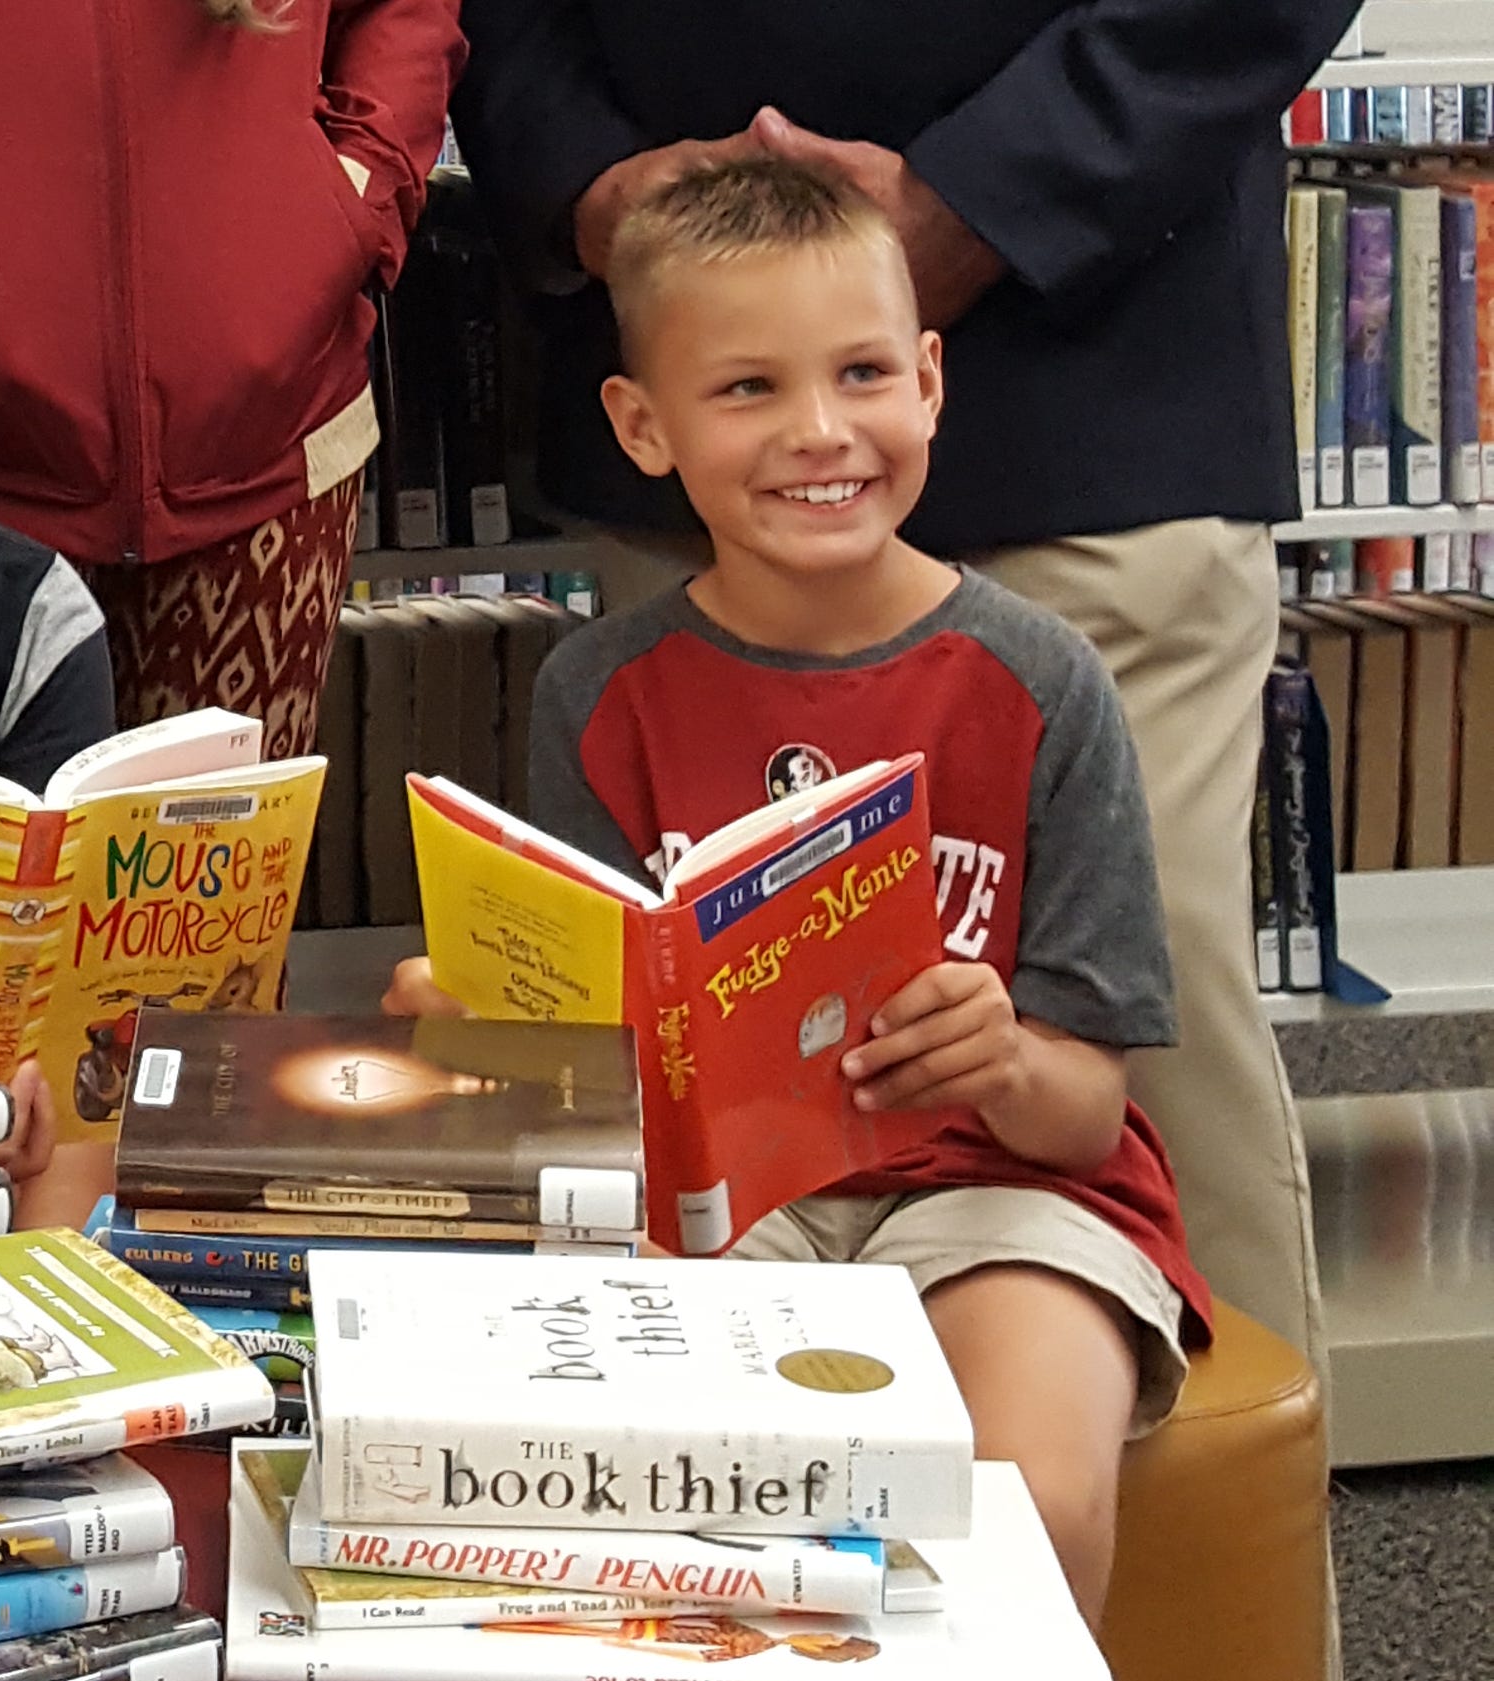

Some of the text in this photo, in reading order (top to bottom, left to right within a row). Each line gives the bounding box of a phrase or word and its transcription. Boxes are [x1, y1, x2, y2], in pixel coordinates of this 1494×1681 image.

[229, 733, 250, 749] FP
[261, 837, 293, 864] AND
[705, 845, 922, 1020] Fudge-a-Mania
[286, 1187, 320, 1206] THE
[325, 1189, 368, 1207] CITY
[393, 1190, 455, 1209] EMBER
[124, 1247, 194, 1265] EULBERG
[241, 1250, 280, 1272] THE
[602, 1278, 691, 1356] thief
[510, 1295, 607, 1382] book
[0, 1442, 31, 1460] Year
[44, 1432, 85, 1451] Lobel
[520, 1440, 575, 1461] THE
[438, 1444, 628, 1517] book
[645, 1447, 831, 1519] thief
[332, 1533, 399, 1570] MR.
[405, 1539, 581, 1584] POPPER'S
[369, 1606, 392, 1619] Can
[497, 1601, 529, 1617] Frog
[533, 1599, 566, 1614] and
[571, 1597, 608, 1614] Toad
[612, 1595, 637, 1612] All
